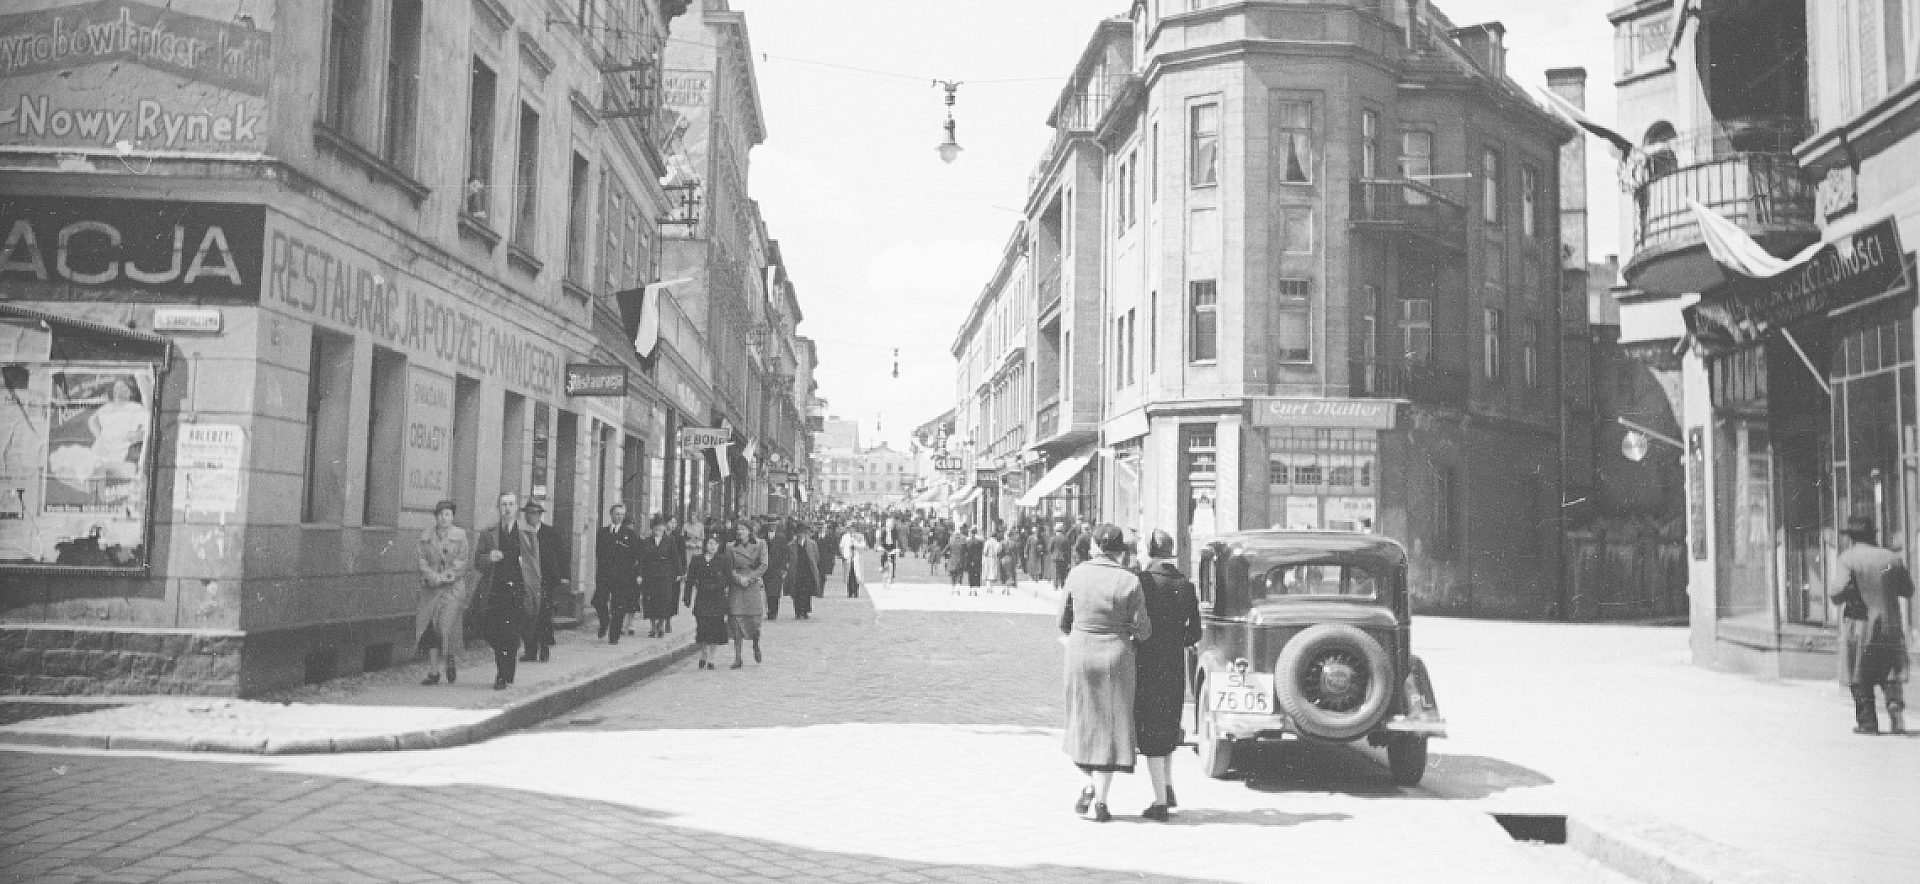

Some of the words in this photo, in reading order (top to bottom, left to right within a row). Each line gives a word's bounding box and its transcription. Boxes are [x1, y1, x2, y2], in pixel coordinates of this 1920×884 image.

[19, 95, 127, 144] Nowy
[137, 100, 257, 147] Rynek
[0, 219, 242, 286] ACJA
[268, 230, 420, 351] RESTAURACJA
[424, 296, 456, 362] POD
[1269, 400, 1308, 415] Curt
[409, 422, 447, 451] OBIADY
[1228, 674, 1256, 689] SL
[1216, 691, 1240, 710] 76
